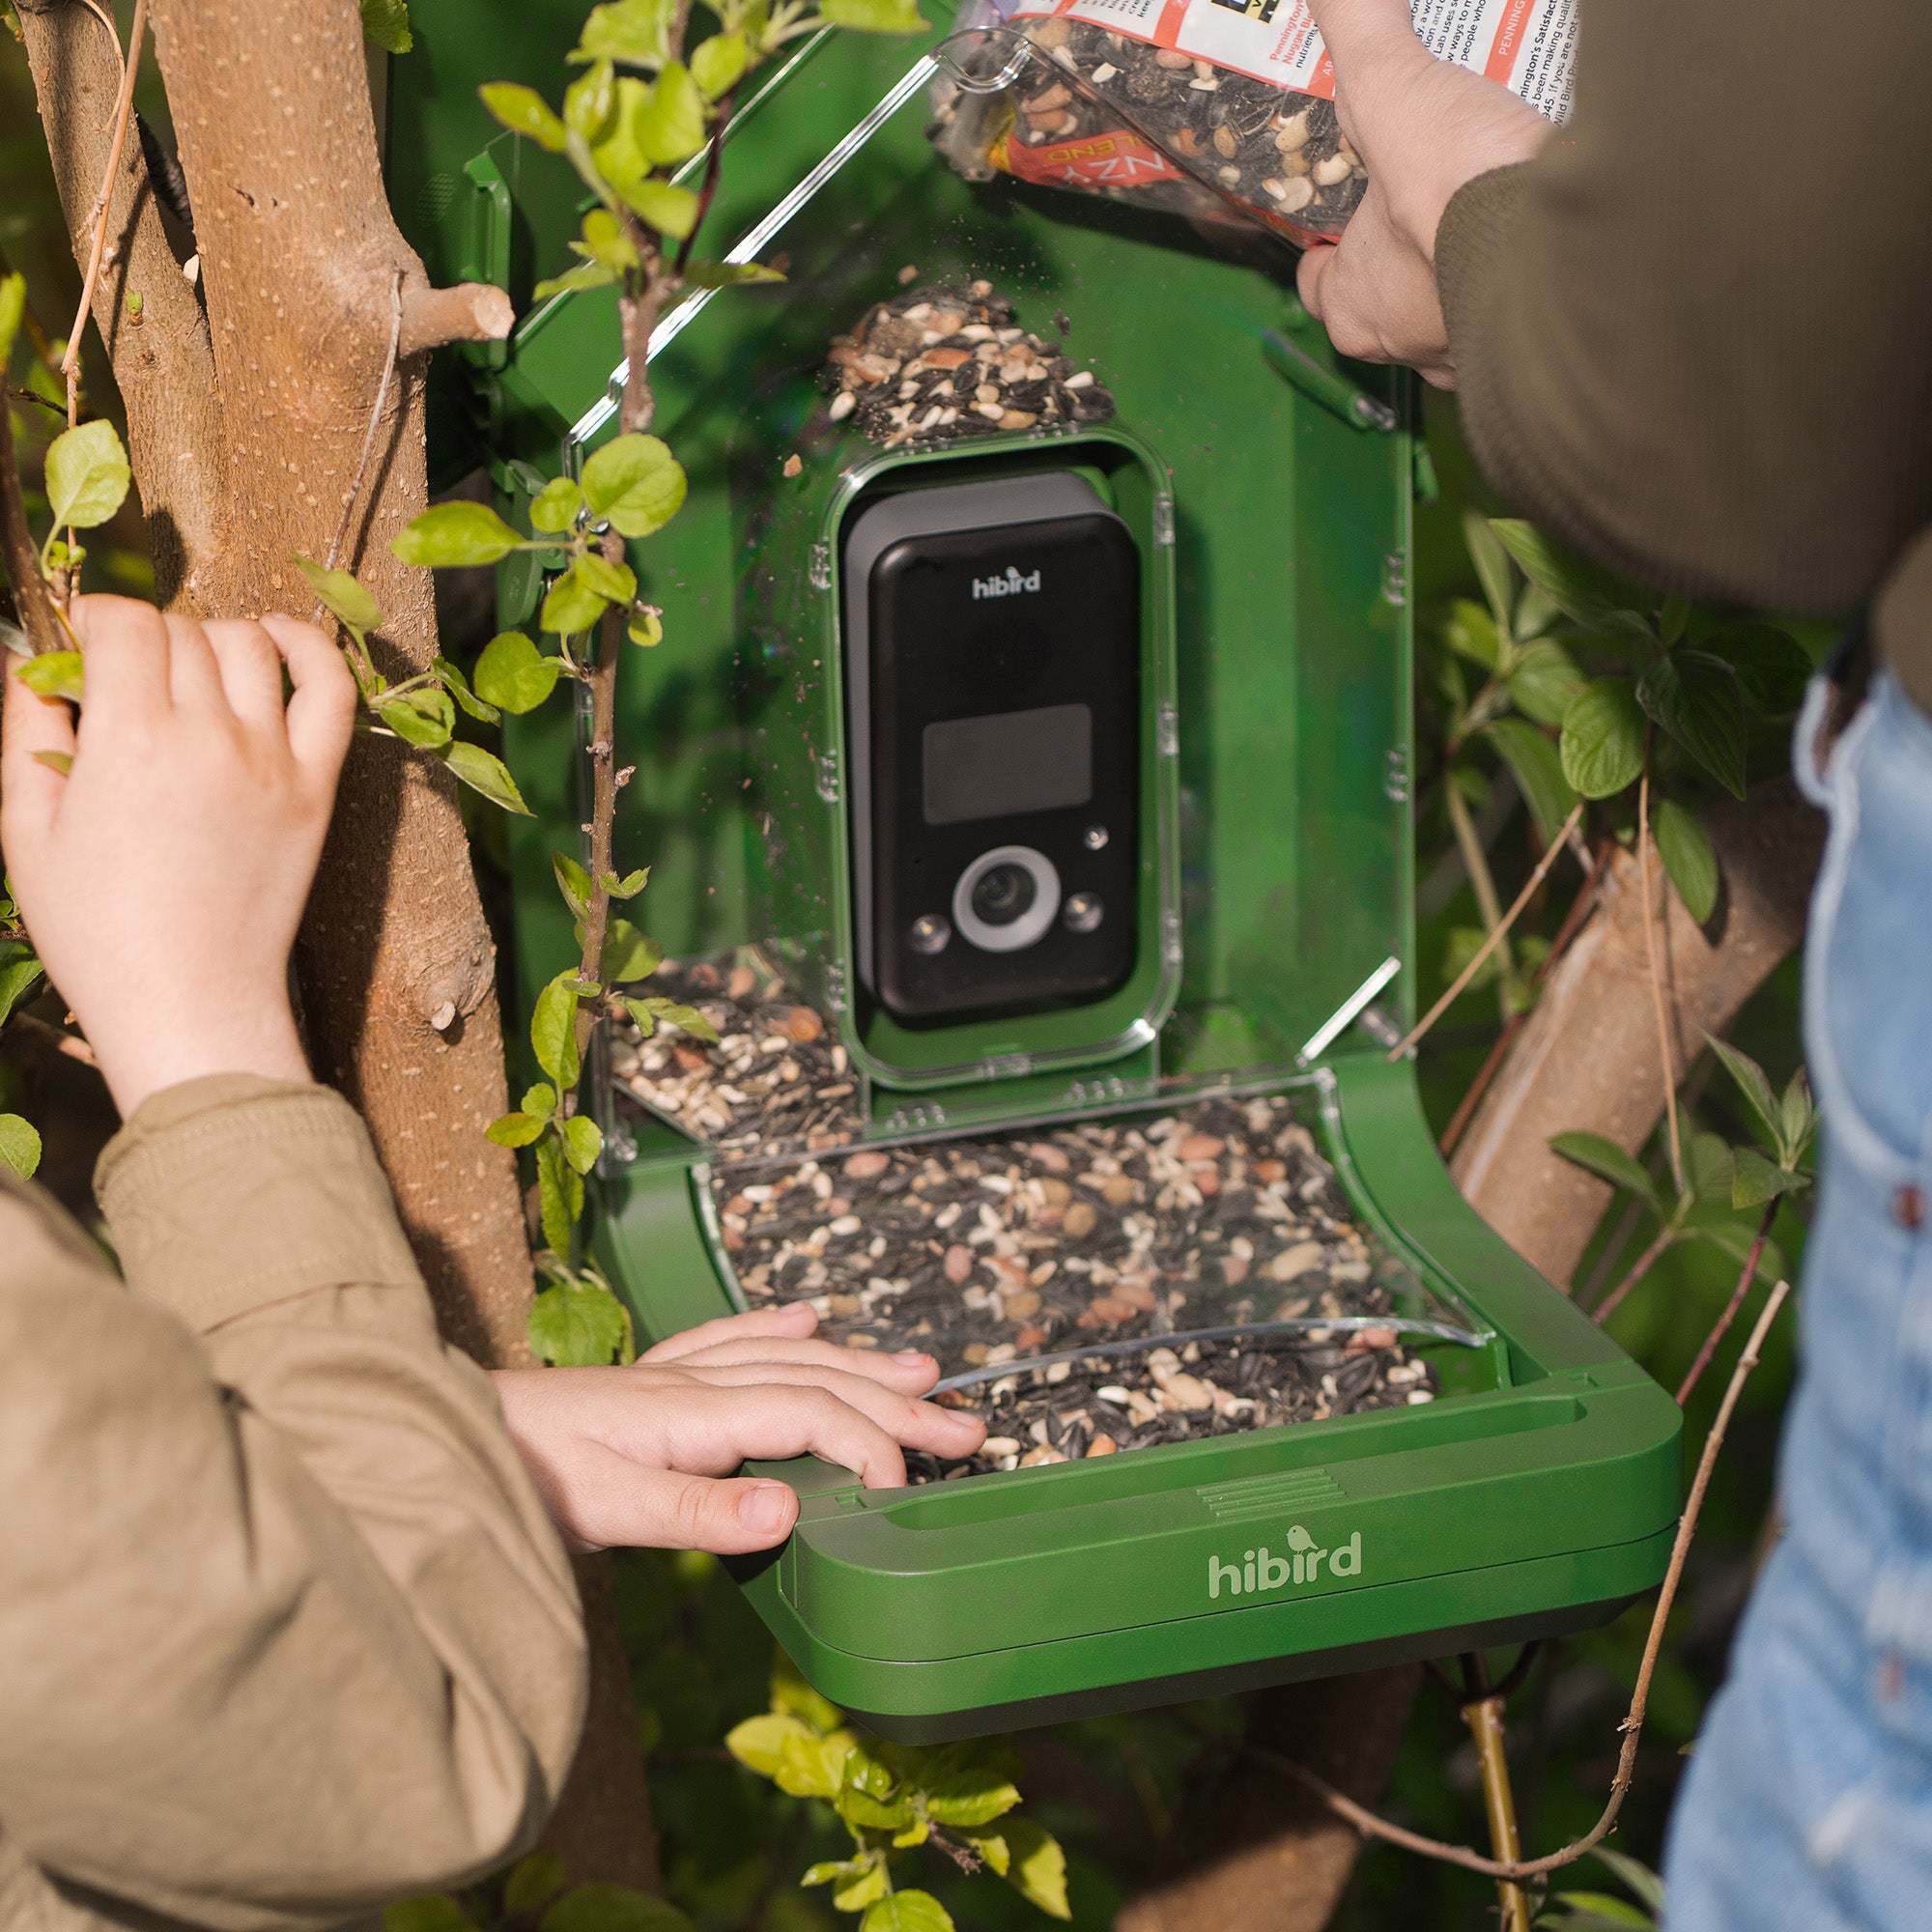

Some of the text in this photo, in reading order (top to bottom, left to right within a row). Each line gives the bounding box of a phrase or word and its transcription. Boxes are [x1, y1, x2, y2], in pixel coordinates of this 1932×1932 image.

[1423, 27, 1436, 48] tion
[1432, 5, 1444, 26] and
[1433, 35, 1447, 54] Lab
[1442, 9, 1456, 33] uses
[1450, 23, 1464, 50] ways
[1459, 10, 1469, 21] to
[1460, 24, 1478, 62] people
[1498, 0, 1526, 56] PENNING
[1566, 20, 1578, 41] not
[1295, 27, 1319, 69] nutrients
[1532, 72, 1548, 100] been
[1543, 30, 1564, 71] making
[1560, 42, 1573, 60] are
[1519, 45, 1543, 101] nington's
[1560, 78, 1575, 101] Bird
[1065, 152, 1175, 184] NZY
[972, 566, 1041, 599] hibird
[1208, 1525, 1362, 1599] hibird
